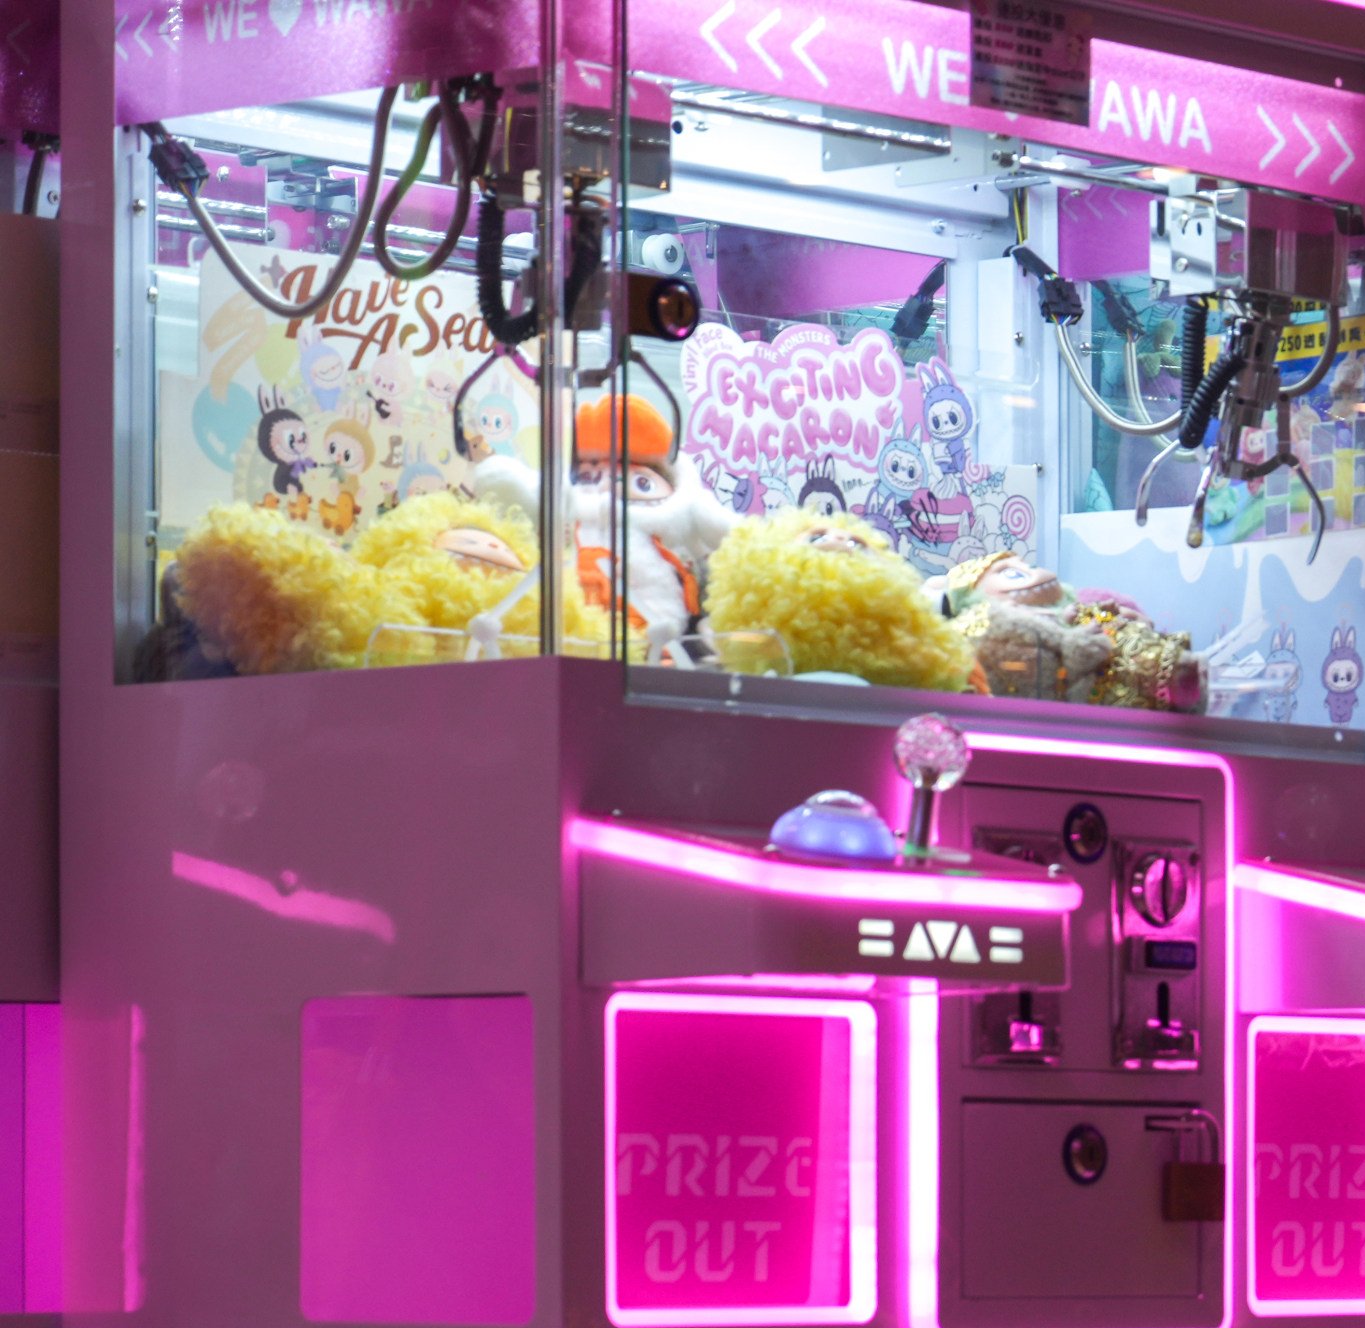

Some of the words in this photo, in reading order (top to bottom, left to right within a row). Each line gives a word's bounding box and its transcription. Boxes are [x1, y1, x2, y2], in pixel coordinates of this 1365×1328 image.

[206, 6, 258, 43] WE
[883, 36, 968, 105] WE
[1093, 76, 1213, 155] AWA
[413, 284, 497, 358] Sea
[757, 345, 778, 363] THE
[778, 330, 831, 358] MONSTERS
[717, 341, 896, 421] EXCITING
[698, 404, 880, 465] MACARON
[617, 1132, 811, 1198] PRIZE
[644, 1219, 782, 1283] OUT
